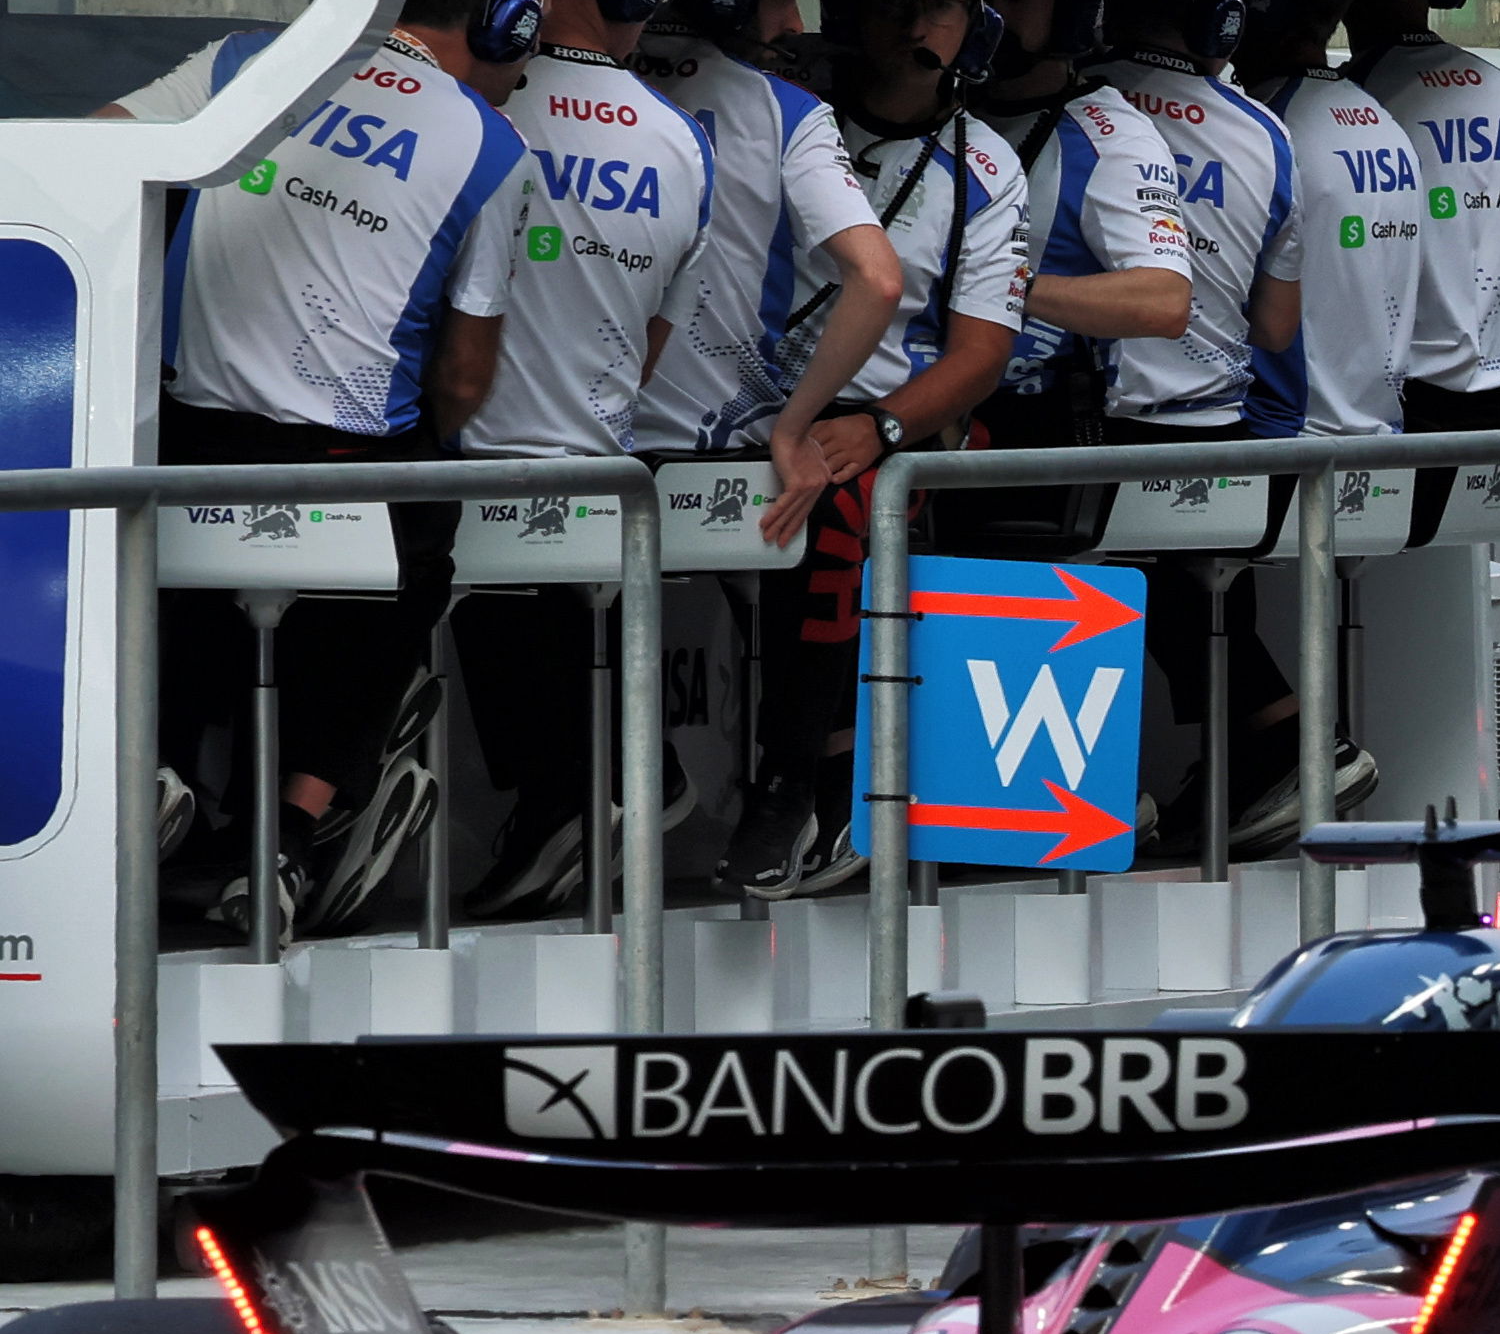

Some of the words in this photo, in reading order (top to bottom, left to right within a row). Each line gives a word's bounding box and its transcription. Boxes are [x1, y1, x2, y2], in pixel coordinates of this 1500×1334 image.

[383, 37, 440, 67] ONDA
[553, 45, 617, 65] HONDA
[1134, 50, 1197, 74] HONDA
[353, 67, 422, 95] UGO
[1307, 67, 1339, 80] HOND
[1418, 68, 1482, 88] HUGO
[548, 95, 639, 127] HUGO
[1123, 90, 1206, 125] HUGO
[1329, 106, 1380, 127] HUGO
[1083, 103, 1116, 137] HUGO
[1333, 147, 1417, 194] VISA
[530, 148, 661, 219] VISA
[285, 176, 339, 213] Cash
[339, 203, 390, 235] App
[1463, 191, 1491, 210] Cash
[1149, 231, 1174, 244] Red
[1370, 221, 1397, 239] Cash
[1398, 223, 1418, 241] App
[572, 234, 616, 259] Cas
[616, 247, 654, 274] App
[1466, 475, 1487, 490] VISA
[668, 493, 702, 510] VISA
[185, 506, 236, 525] VISA
[325, 512, 344, 521] Cash
[345, 513, 362, 522] App
[479, 504, 518, 522] VISA
[588, 507, 604, 516] Cash
[605, 507, 617, 518] App
[630, 1045, 1006, 1140] BANCO
[1024, 1037, 1250, 1135] BRB
